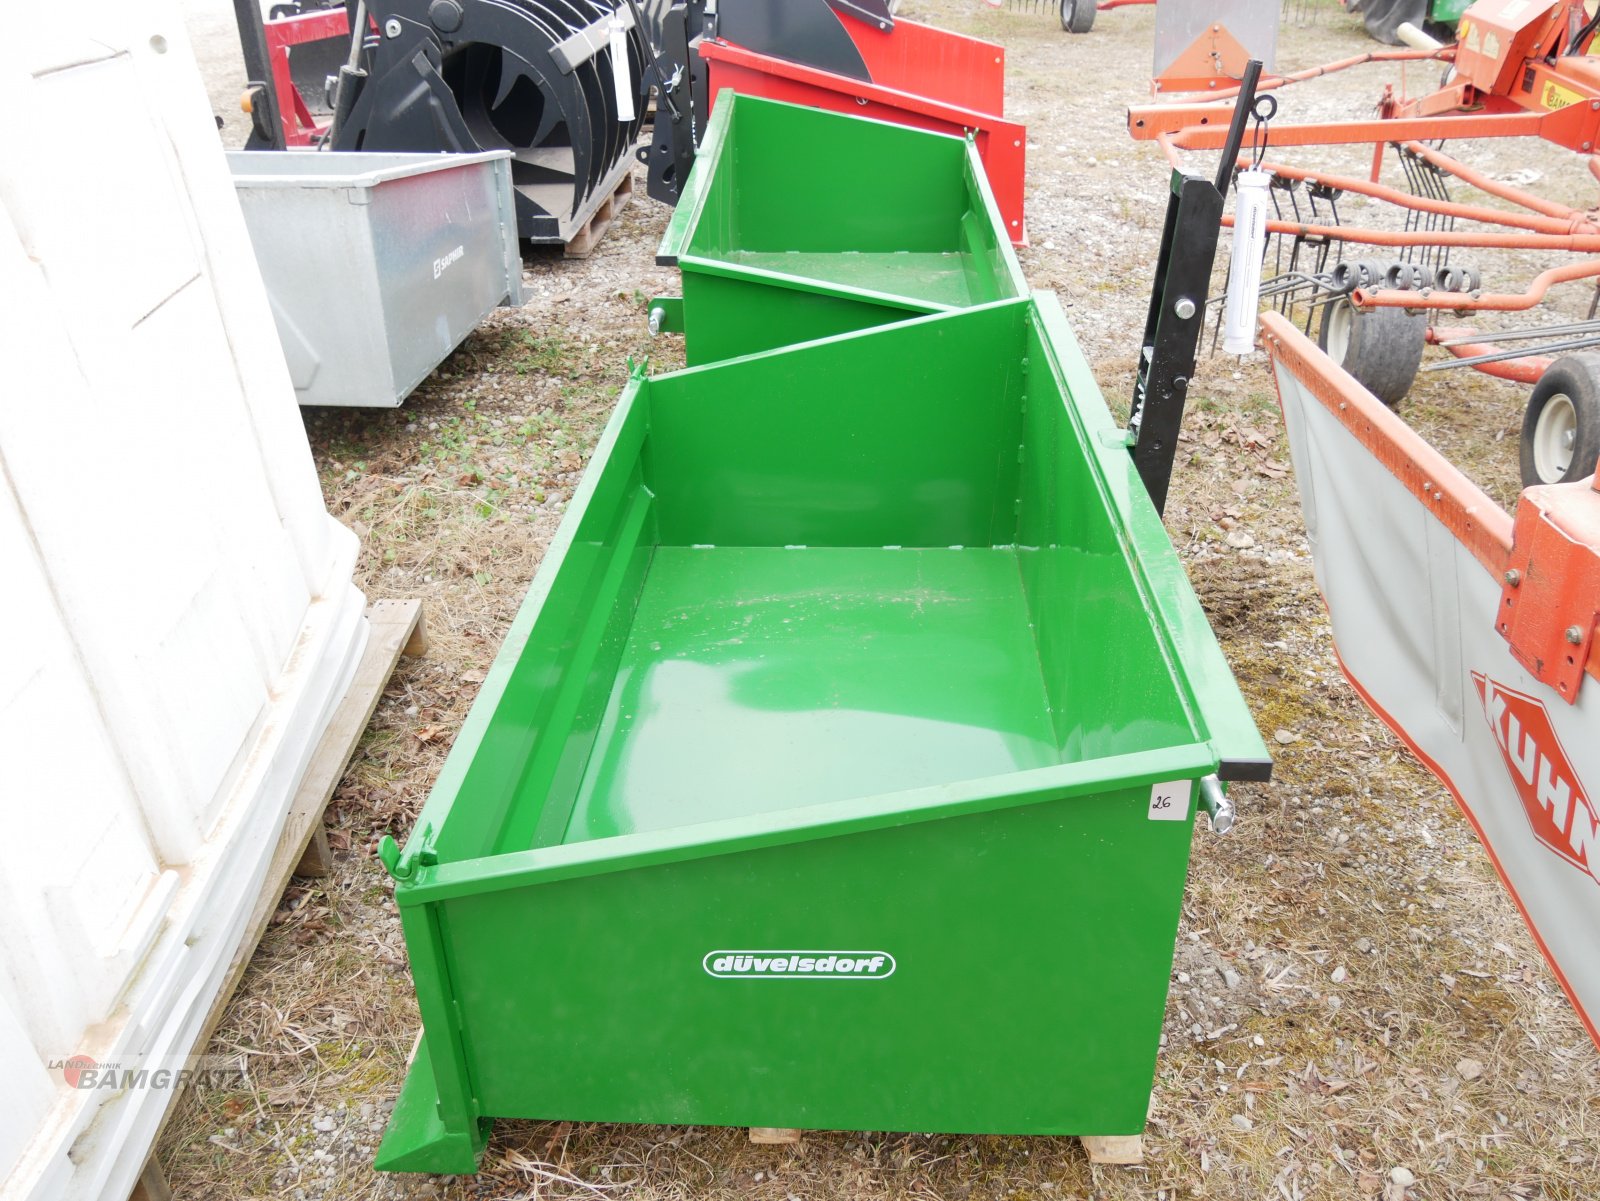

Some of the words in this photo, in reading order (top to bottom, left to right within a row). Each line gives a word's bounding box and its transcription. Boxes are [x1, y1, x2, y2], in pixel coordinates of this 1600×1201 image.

[441, 245, 464, 271] SAPHIR
[1152, 795, 1172, 809] 26
[713, 955, 885, 973] düvelsdorf
